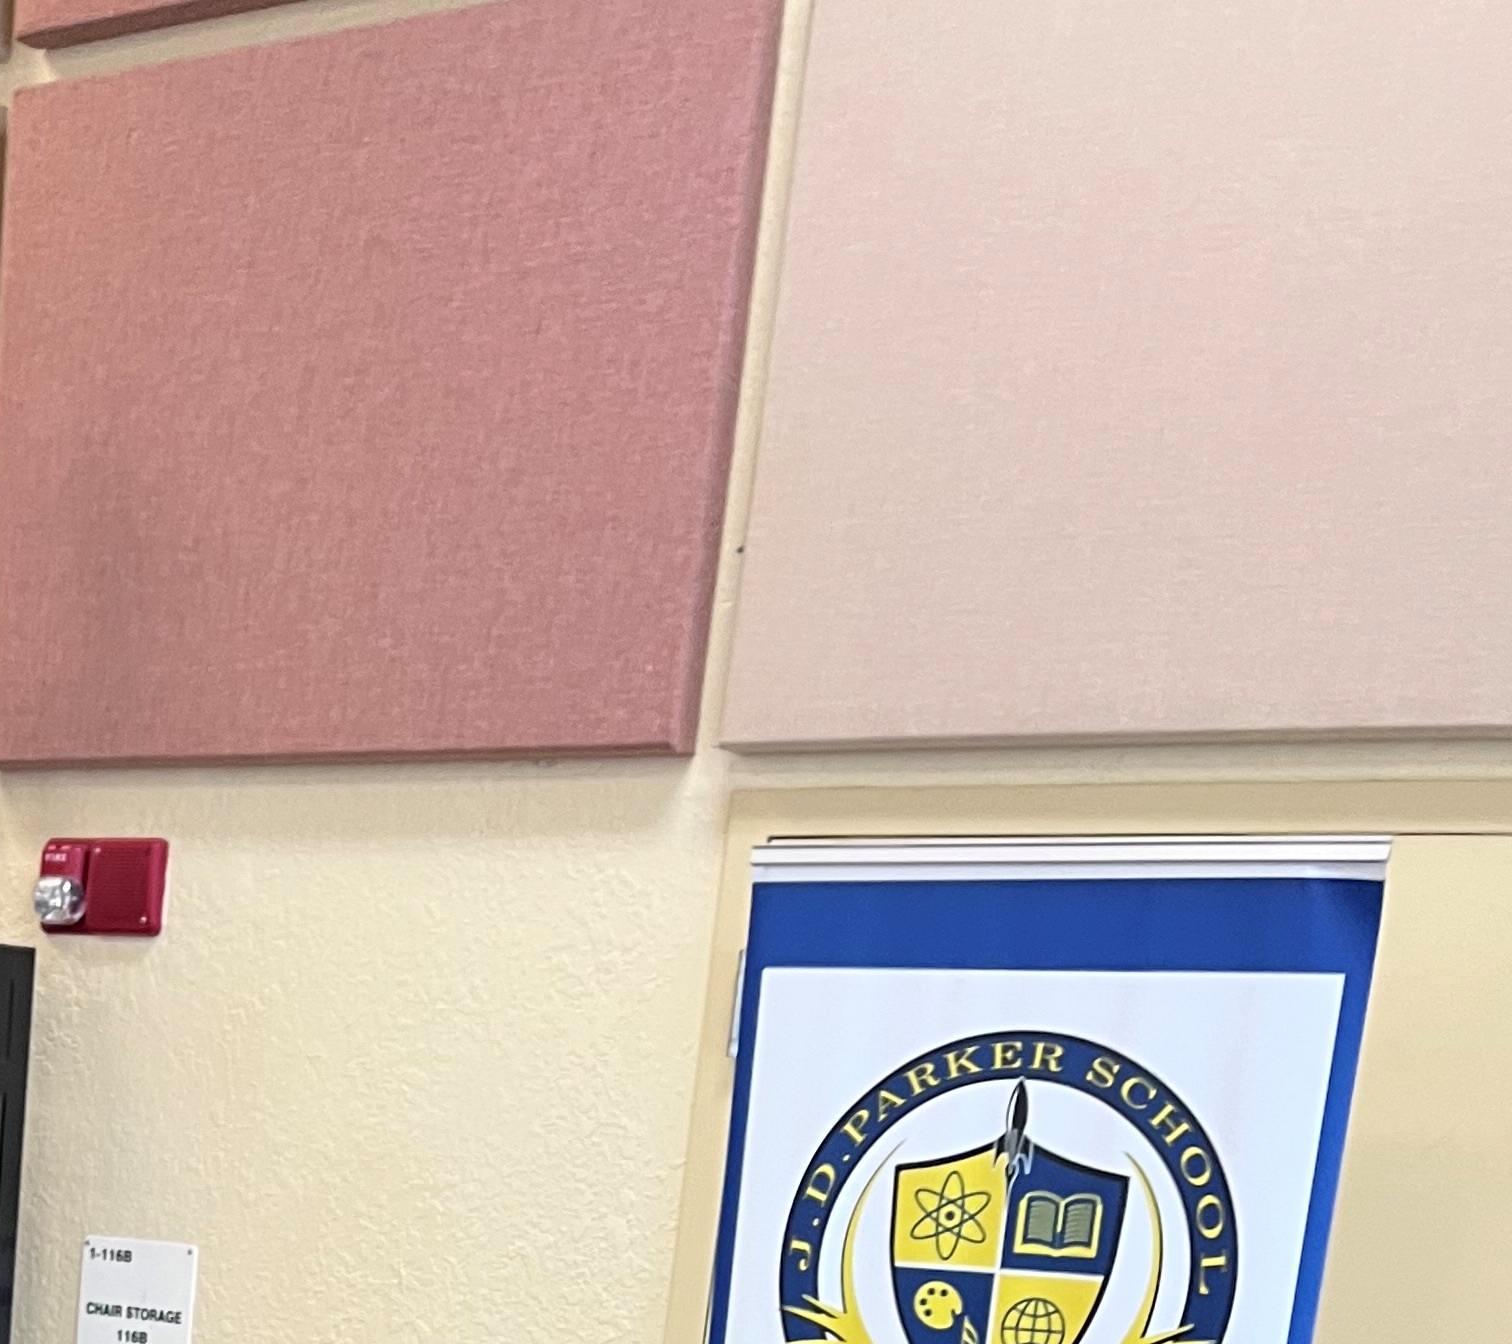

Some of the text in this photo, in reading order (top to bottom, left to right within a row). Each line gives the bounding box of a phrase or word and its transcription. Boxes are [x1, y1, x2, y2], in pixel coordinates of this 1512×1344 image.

[1085, 1056, 1228, 1295] SCHOOL
[90, 1248, 133, 1263] 1-116B
[86, 1302, 183, 1325] CHAIR STORAGE
[117, 1330, 148, 1344] 116B
